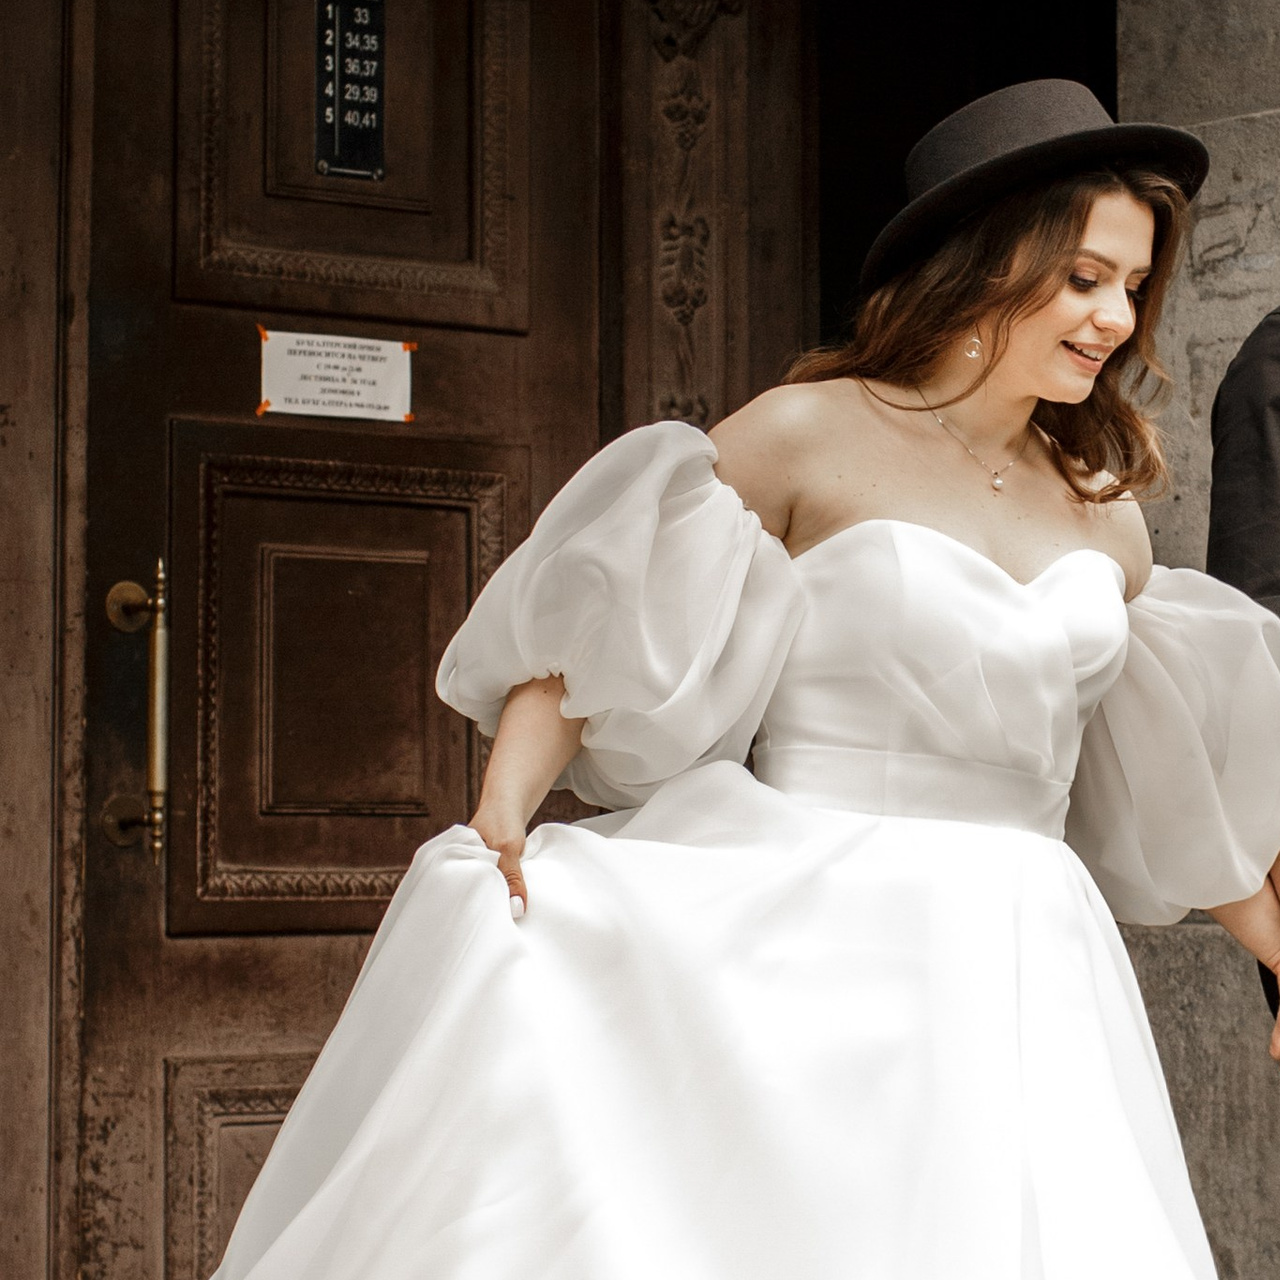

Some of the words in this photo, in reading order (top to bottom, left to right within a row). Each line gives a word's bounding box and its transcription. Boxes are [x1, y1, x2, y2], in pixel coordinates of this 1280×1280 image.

[326, 4, 333, 19] 1
[354, 7, 369, 24] 33
[325, 29, 333, 46] 2
[345, 31, 378, 52] 34,35
[325, 55, 333, 72] 3
[324, 81, 334, 97] 4
[325, 107, 334, 123] 5
[344, 110, 376, 128] 40,41
